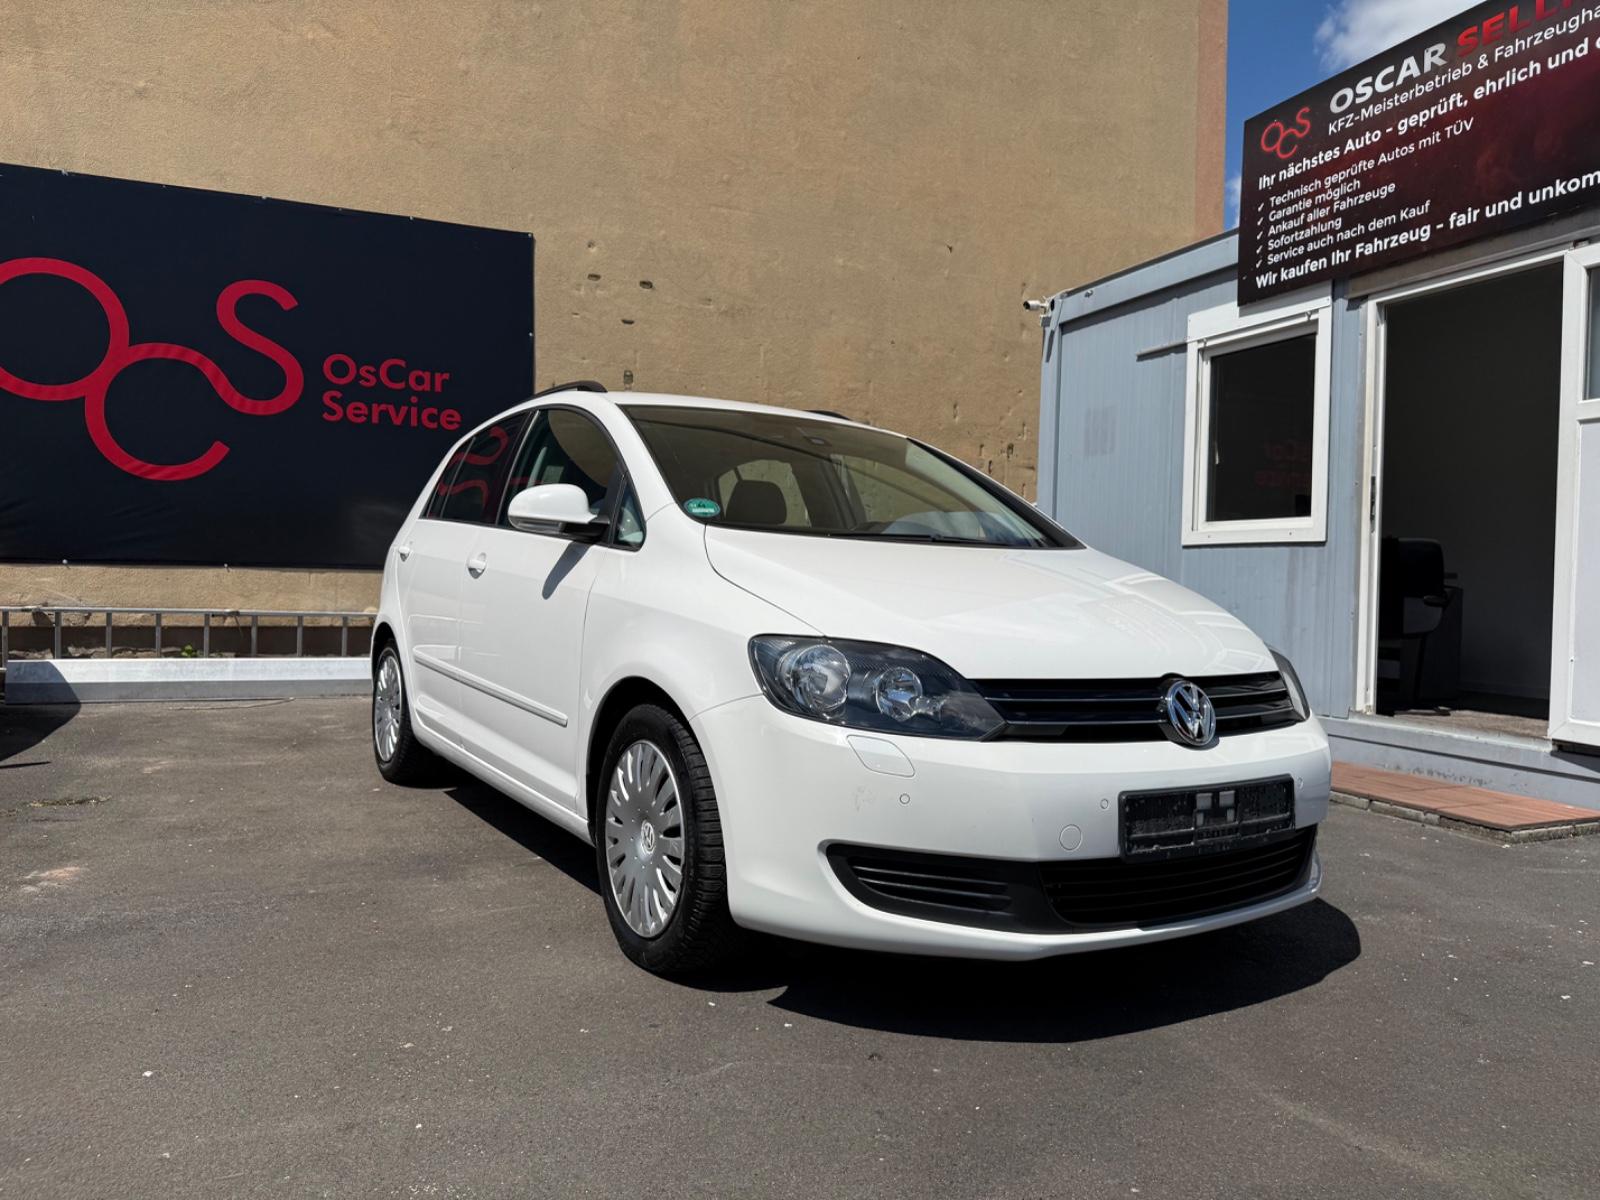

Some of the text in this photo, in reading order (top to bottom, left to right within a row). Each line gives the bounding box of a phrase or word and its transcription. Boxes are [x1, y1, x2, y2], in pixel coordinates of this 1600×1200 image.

[1329, 0, 1573, 114] OSCAR SELL
[1258, 173, 1276, 190] Ihr
[1278, 146, 1340, 182] nächstes
[1343, 129, 1381, 155] Auto
[1397, 92, 1468, 136] geprüft,
[1473, 60, 1541, 100] ehrlich
[1547, 37, 1589, 69] und
[1328, 62, 1472, 136] KFZ-Meisterbetrieb
[1477, 53, 1489, 70] &
[1269, 116, 1474, 207] Technisch geprüfte Autos mit TÜV
[1267, 182, 1396, 237] Ankauf aller Fahrzeuge
[1267, 199, 1431, 265] Service auch nach dem Kauf
[1267, 216, 1342, 251] Sofortzahlung
[1268, 180, 1361, 222] Garantie möglich
[1255, 271, 1278, 289] Wir
[1280, 256, 1328, 281] kaufen
[1331, 249, 1352, 266] Ihr
[1355, 224, 1431, 259] Fahrzeug
[1449, 206, 1480, 230] fair
[1485, 191, 1522, 218] und
[322, 353, 450, 393] OsCar
[321, 390, 463, 431] Service
